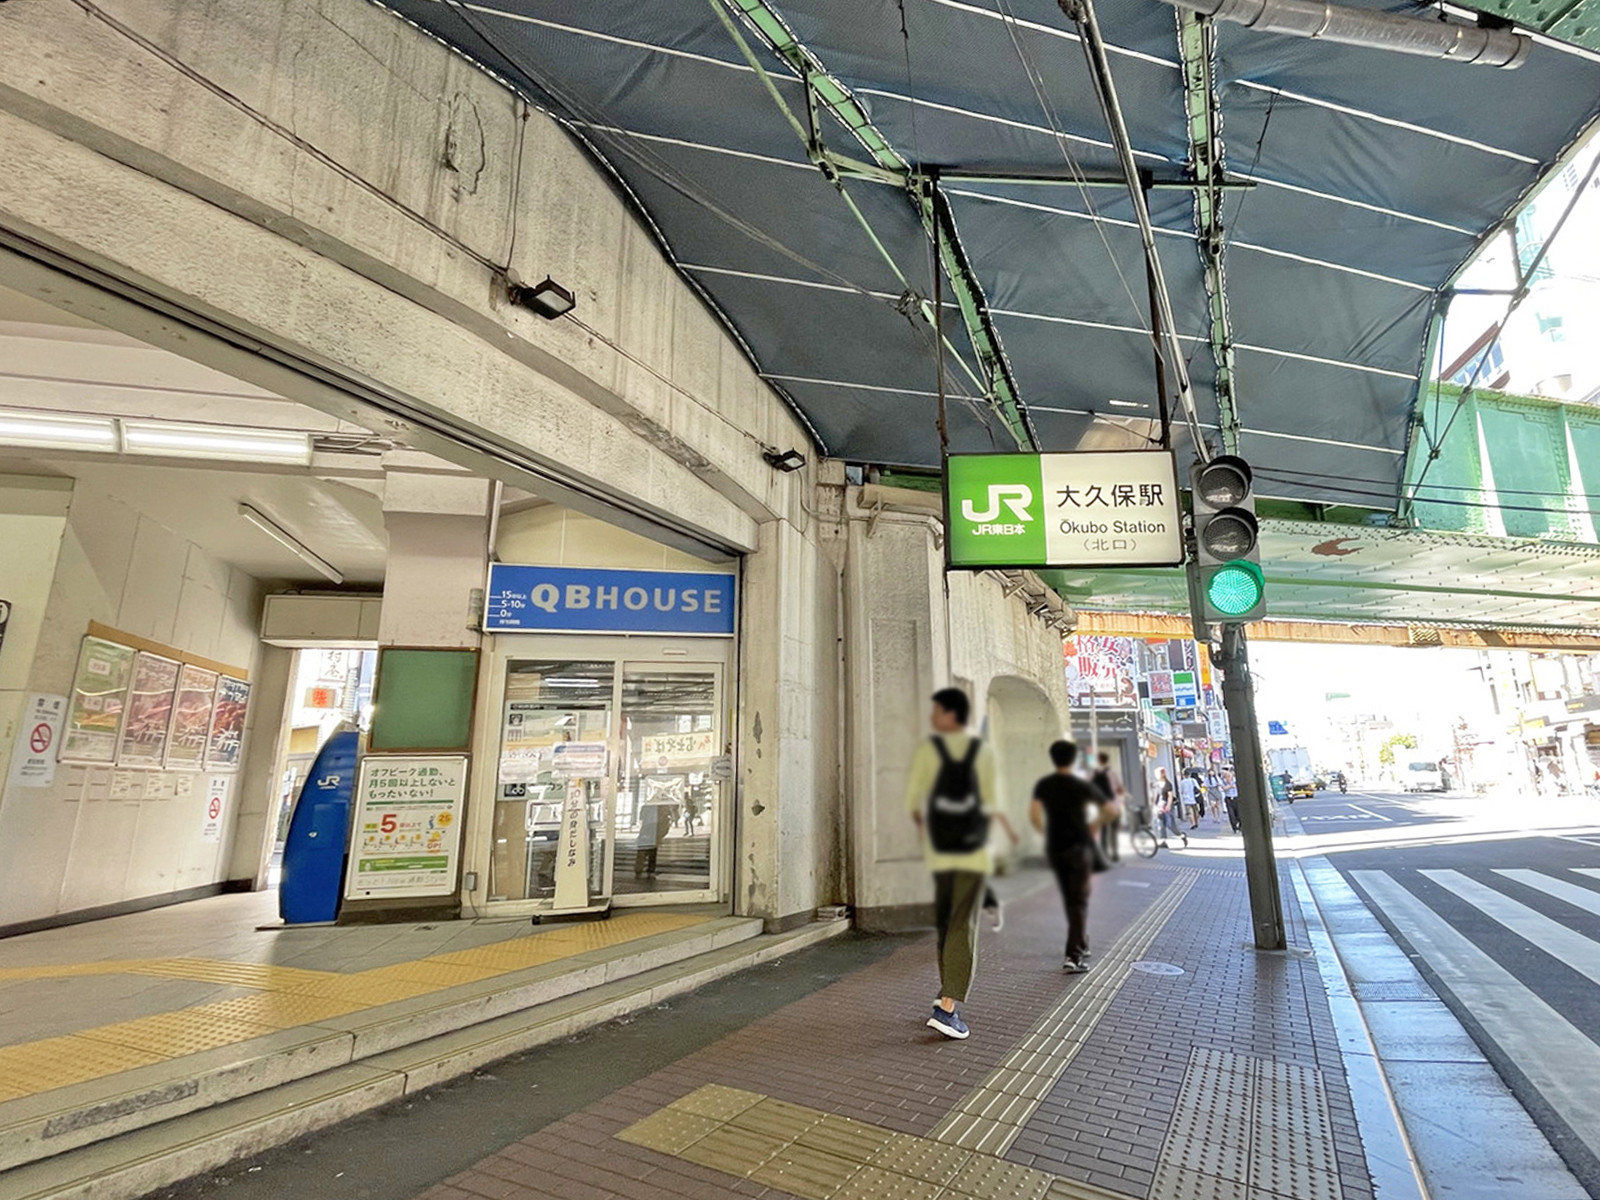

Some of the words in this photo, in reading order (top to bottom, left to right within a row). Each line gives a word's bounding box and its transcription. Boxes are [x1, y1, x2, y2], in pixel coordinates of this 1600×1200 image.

[961, 484, 1034, 522] JR
[1056, 484, 1164, 507] 大久保駅
[972, 523, 1026, 535] JR東日本
[1060, 519, 1108, 534] Ōkubo
[1113, 520, 1166, 533] Station
[317, 775, 341, 786] JR
[380, 814, 397, 833] 5
